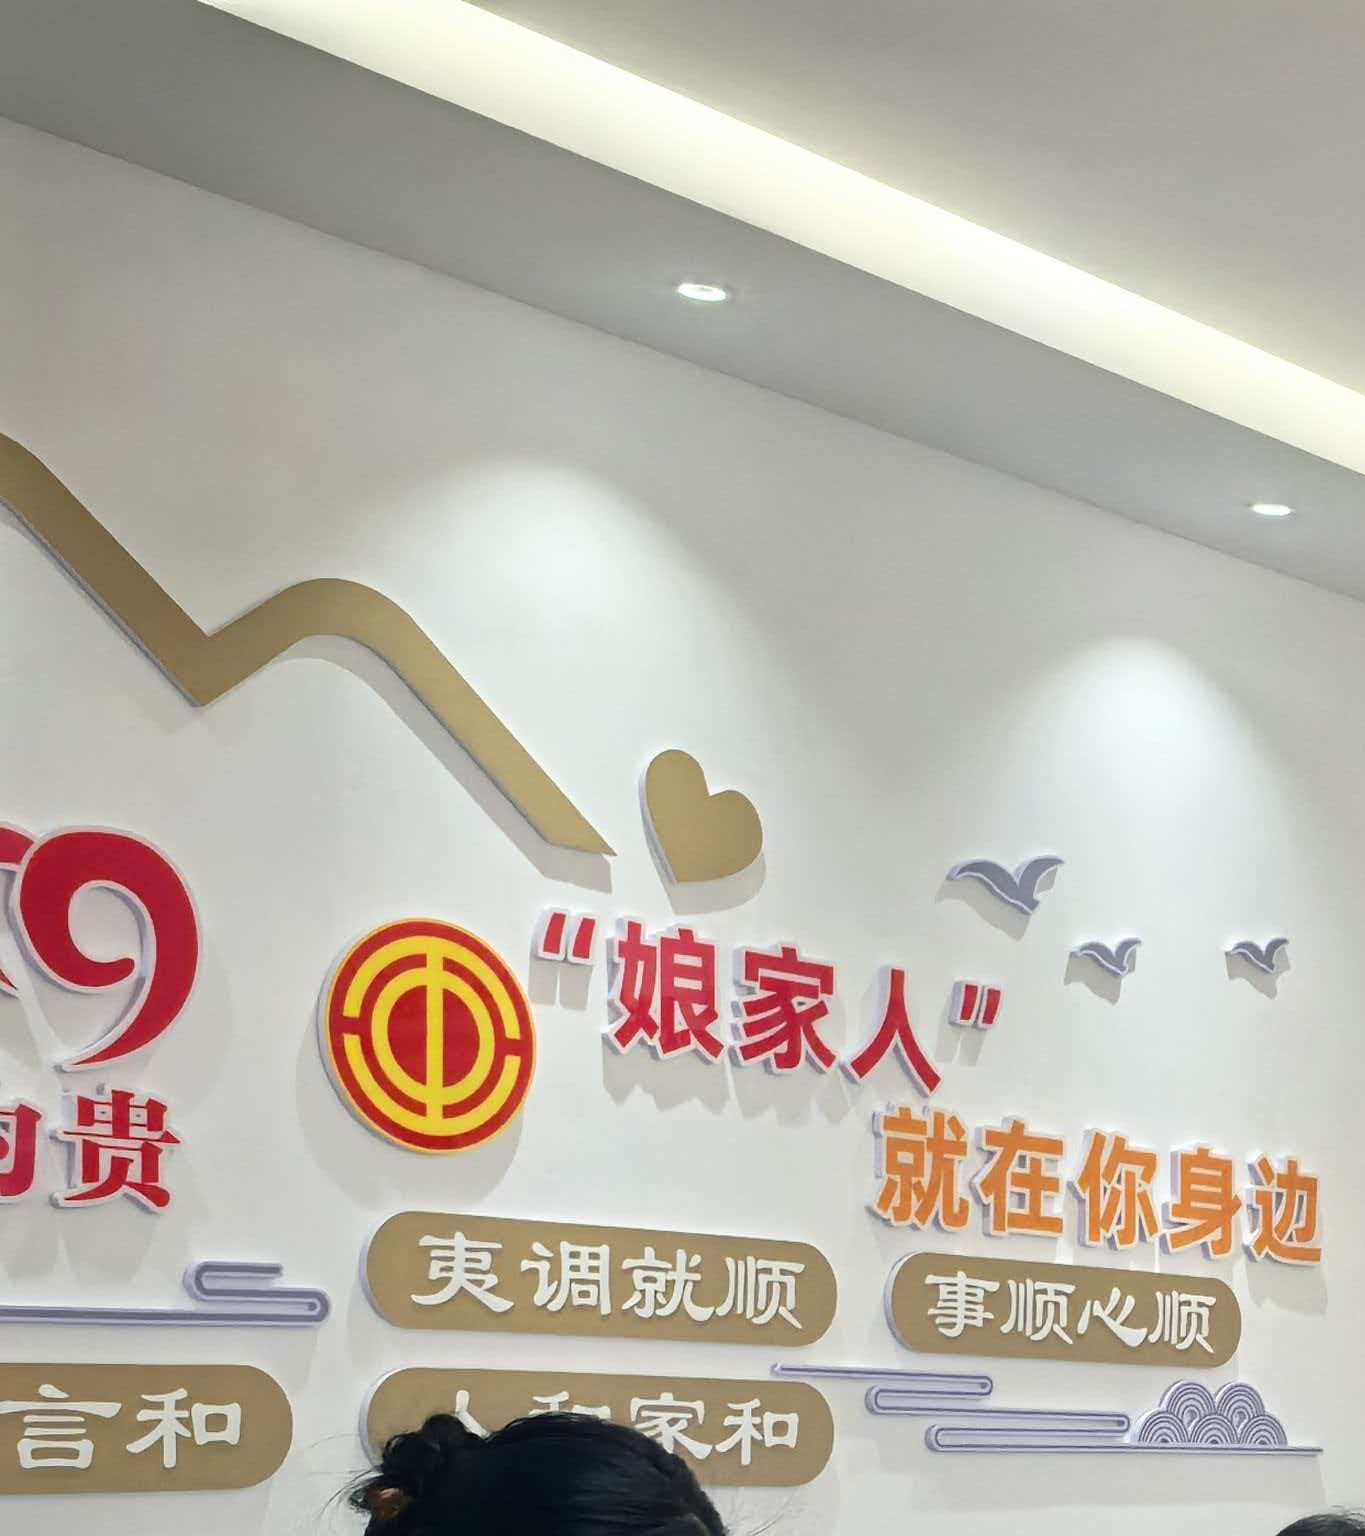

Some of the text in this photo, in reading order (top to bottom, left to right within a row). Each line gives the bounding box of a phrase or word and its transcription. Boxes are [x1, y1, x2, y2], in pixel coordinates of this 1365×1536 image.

[541, 911, 1002, 1094] “娘家人”
[875, 1107, 1322, 1263] 就在你身边
[925, 1272, 1217, 1355] 事顺心顺
